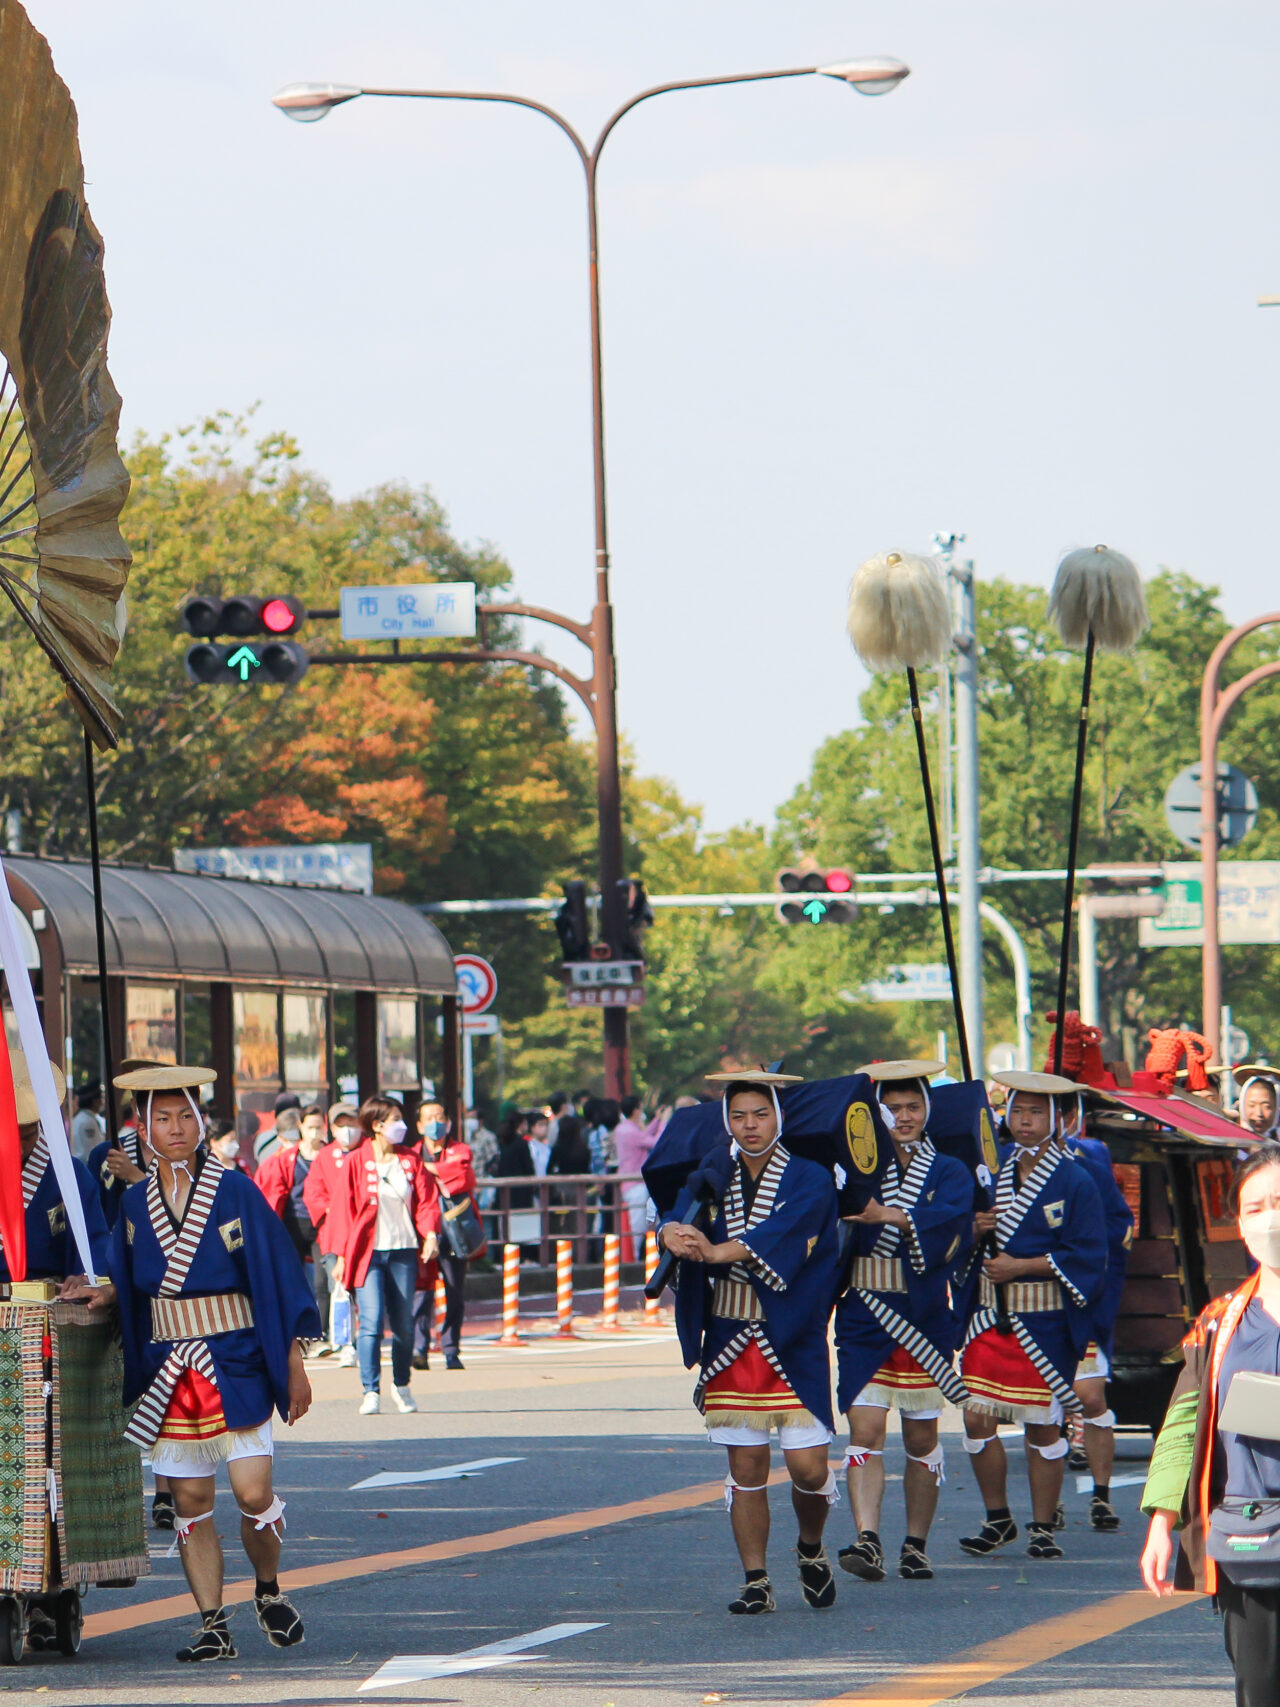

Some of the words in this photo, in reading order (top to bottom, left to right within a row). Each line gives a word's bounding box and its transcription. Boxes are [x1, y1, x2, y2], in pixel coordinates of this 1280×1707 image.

[358, 593, 455, 616] 市役所
[382, 618, 403, 632] City
[412, 618, 434, 629] Hall
